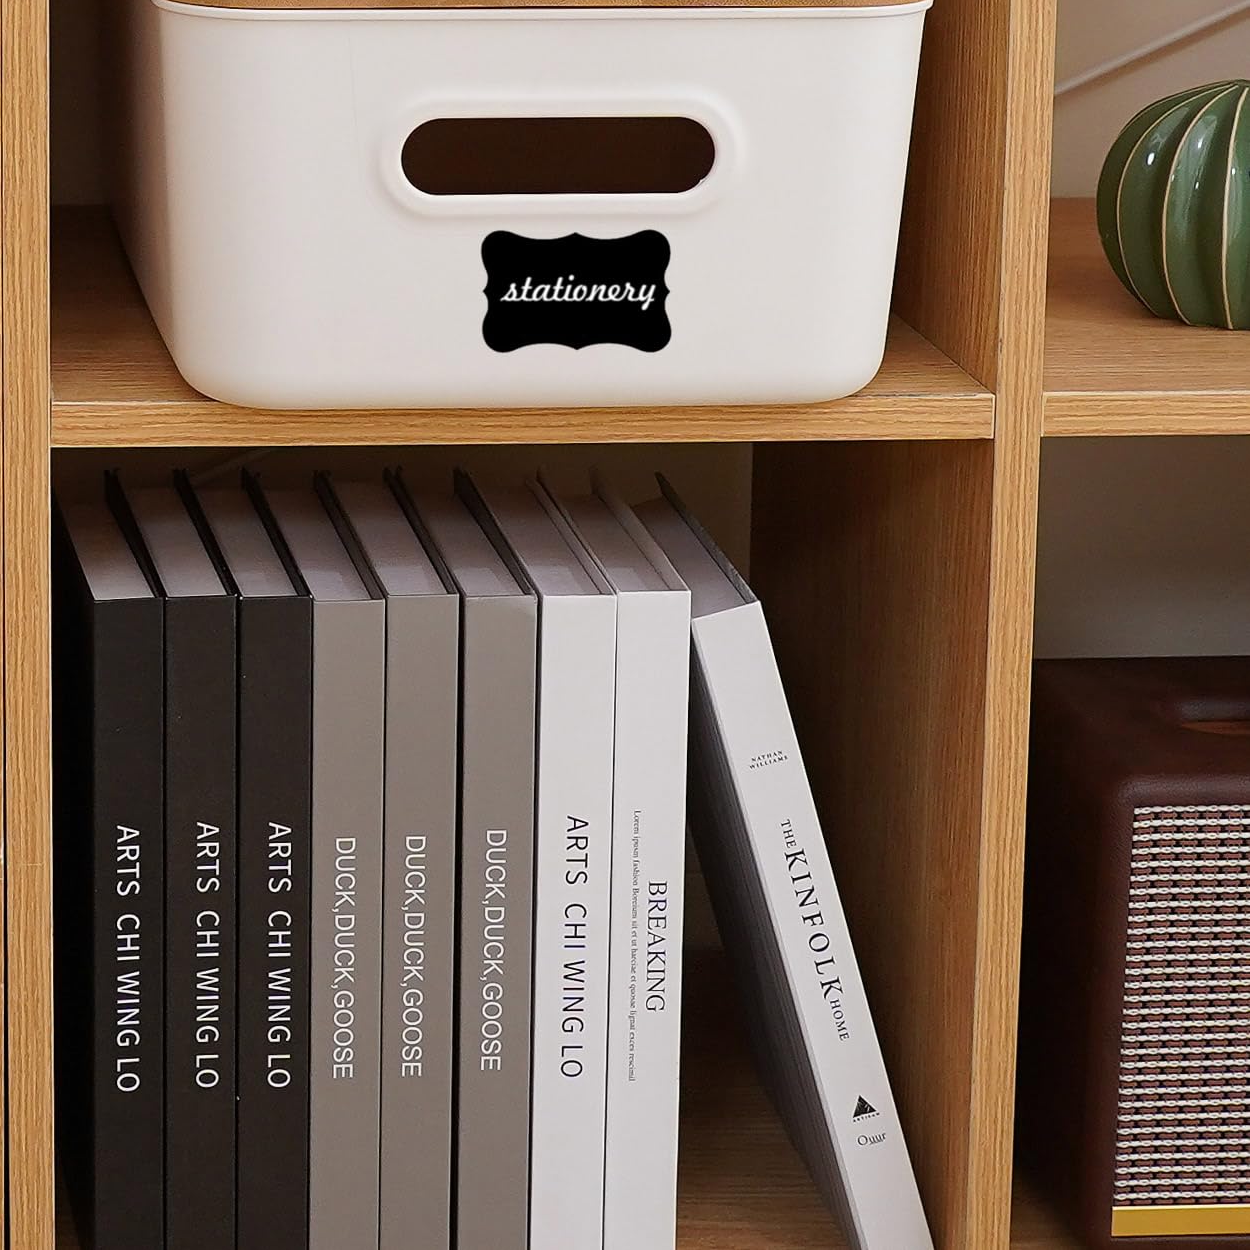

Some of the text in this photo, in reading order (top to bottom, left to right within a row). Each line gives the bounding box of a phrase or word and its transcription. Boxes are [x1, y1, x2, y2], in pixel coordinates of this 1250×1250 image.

[500, 274, 656, 311] stationery
[633, 810, 641, 834] Lorem
[749, 755, 788, 770] WILLIAMS
[116, 825, 140, 1093] ARTS CHI WING LO
[195, 821, 220, 1088] ARTS CHI WING LO
[267, 821, 292, 1088] ARTS CHI WING LO
[560, 815, 589, 1078] ARTS CHI WING LO
[645, 880, 668, 1012] BREAKING
[780, 819, 850, 1041] THE KINFOLK HOME
